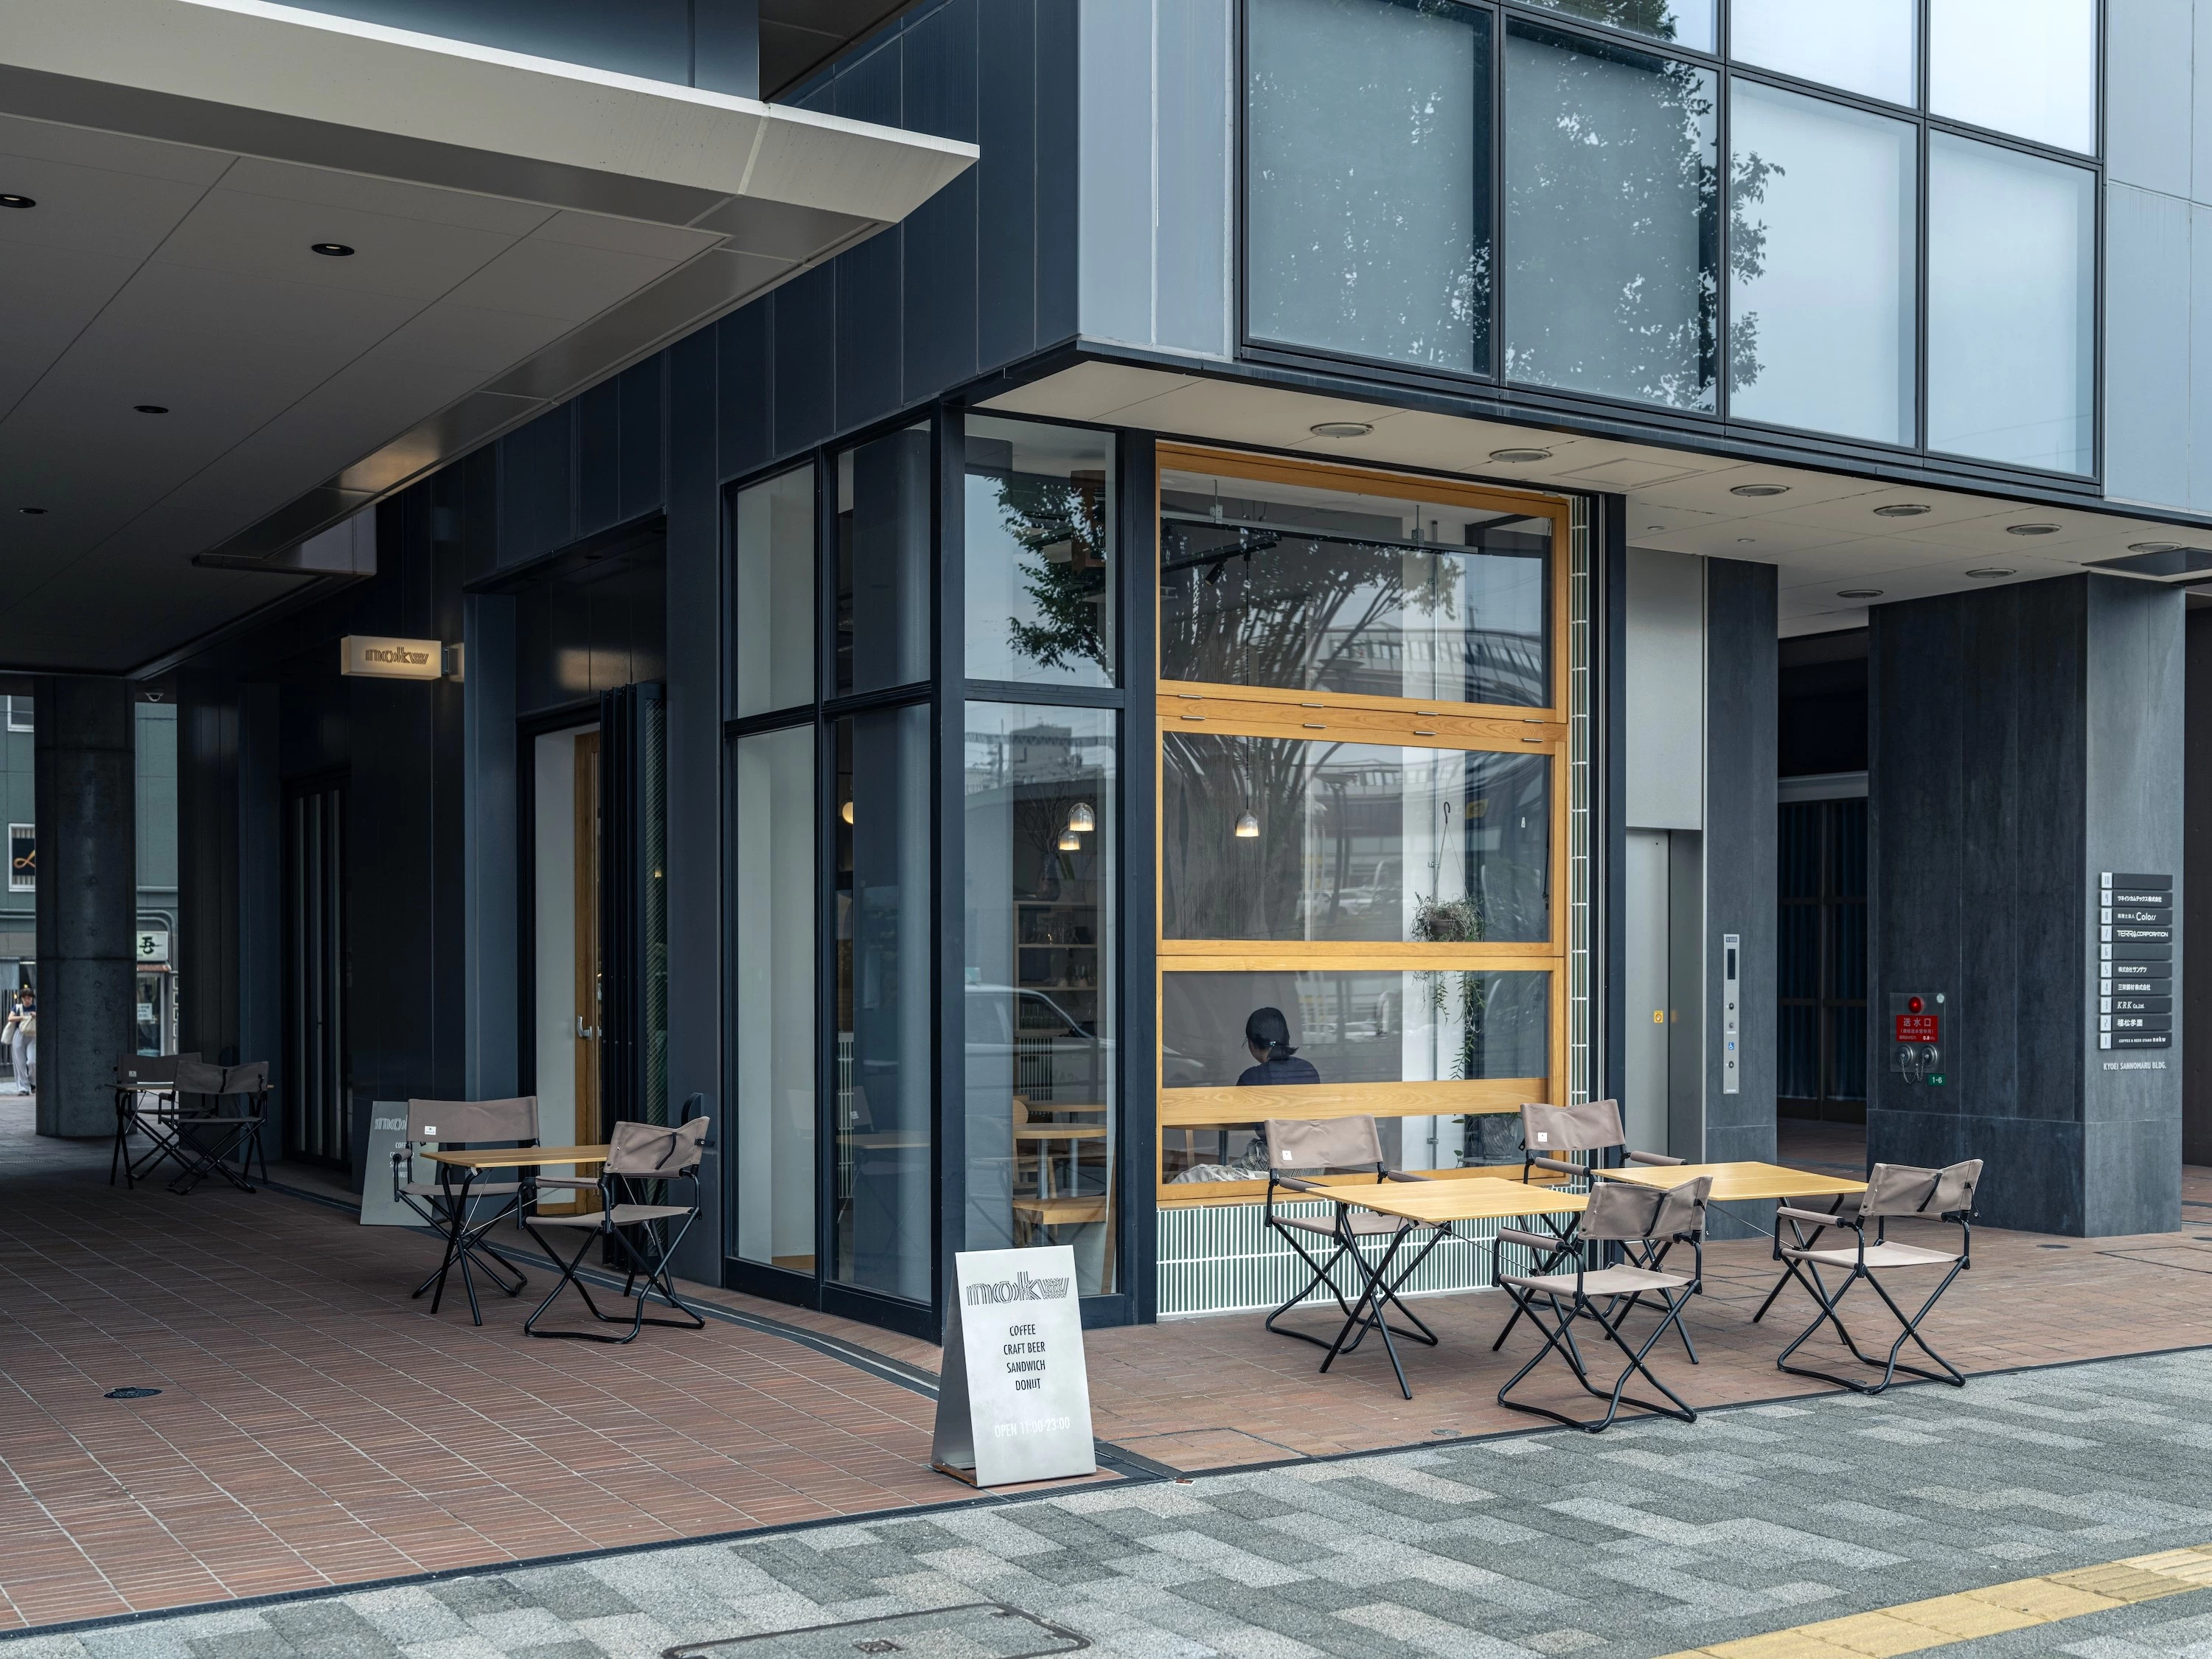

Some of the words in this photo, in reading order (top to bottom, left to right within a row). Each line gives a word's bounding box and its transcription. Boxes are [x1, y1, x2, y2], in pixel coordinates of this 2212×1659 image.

[2105, 894, 2109, 903] 9
[2136, 911, 2157, 921] Colors
[2105, 929, 2109, 938] 7
[2104, 965, 2109, 974] 5
[1903, 1018, 1931, 1026] 送水口
[2104, 1018, 2108, 1027] 2
[2104, 1062, 2119, 1071] KYOEI
[2120, 1062, 2152, 1070] SANNOMARU
[2152, 1061, 2167, 1069] BLDG.
[1009, 1324, 1036, 1336] COFFEE
[1004, 1343, 1026, 1355] CRAFT
[1028, 1341, 1046, 1353] BEER
[1006, 1360, 1046, 1374] SANDWICH
[1015, 1378, 1041, 1391] DONUT
[995, 1423, 1018, 1439] OPEN
[1020, 1416, 1071, 1435] 11:00-23:00
